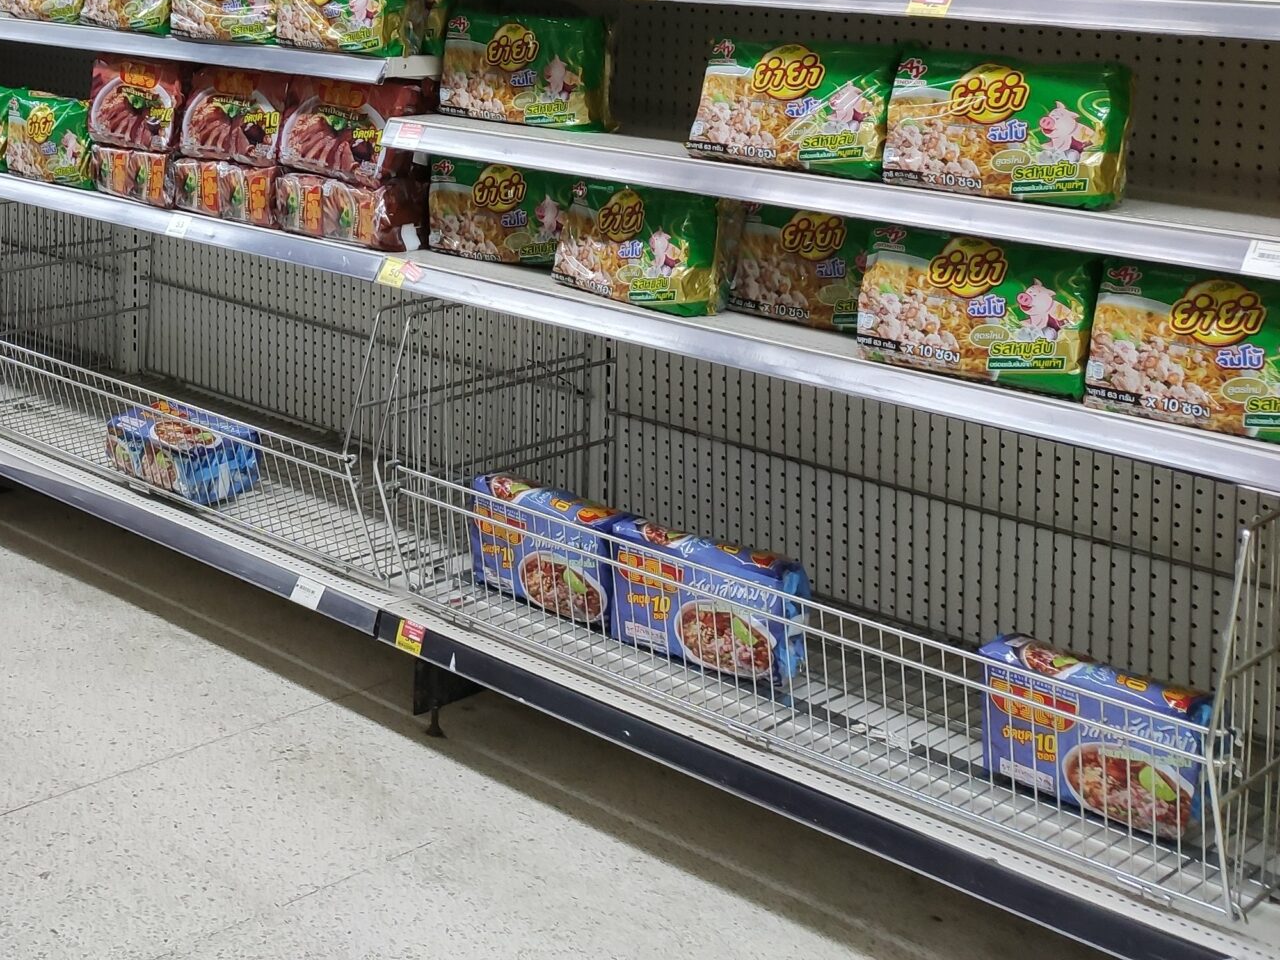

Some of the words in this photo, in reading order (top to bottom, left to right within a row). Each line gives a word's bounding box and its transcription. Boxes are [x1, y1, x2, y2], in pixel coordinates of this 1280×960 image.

[486, 31, 540, 66] ยำยำ
[753, 54, 825, 92] ยำยำ
[950, 72, 1029, 116] ยำยำ
[263, 111, 280, 128] 10
[802, 130, 857, 151] รสหมูสับ
[987, 120, 1027, 144] จัมโบ้
[742, 146, 756, 158] 10
[757, 149, 777, 159] ซอง
[941, 173, 956, 185] 10
[958, 176, 982, 189] ซอง
[1013, 160, 1078, 184] รสหมูสับ
[472, 172, 527, 207] ยำยำ
[598, 200, 645, 234] ยำยำ
[782, 216, 847, 253] ยำยำ
[927, 246, 1008, 289] ยำยำ
[774, 303, 786, 316] 10
[788, 307, 811, 319] ซอง
[968, 294, 1007, 318] จัมโบ้
[1170, 290, 1267, 335] ยำยำ
[882, 339, 896, 350] กรัม
[973, 329, 1005, 340] สูตรใหม่
[918, 344, 933, 358] 10
[935, 347, 961, 363] ซอง
[990, 337, 1056, 361] รสหมูสับ
[1215, 344, 1266, 371] จัมโบ้
[1032, 356, 1063, 369] หมูแท้ๆ
[1118, 391, 1136, 403] กรัม
[1227, 382, 1262, 396] สูตรใหม่
[1161, 397, 1179, 413] 10
[1181, 401, 1212, 418] ซอง
[502, 547, 515, 562] 10
[651, 595, 671, 613] 10
[1002, 726, 1033, 745] จัดชุด
[1036, 732, 1056, 752] 10
[1036, 751, 1056, 761] ซอง
